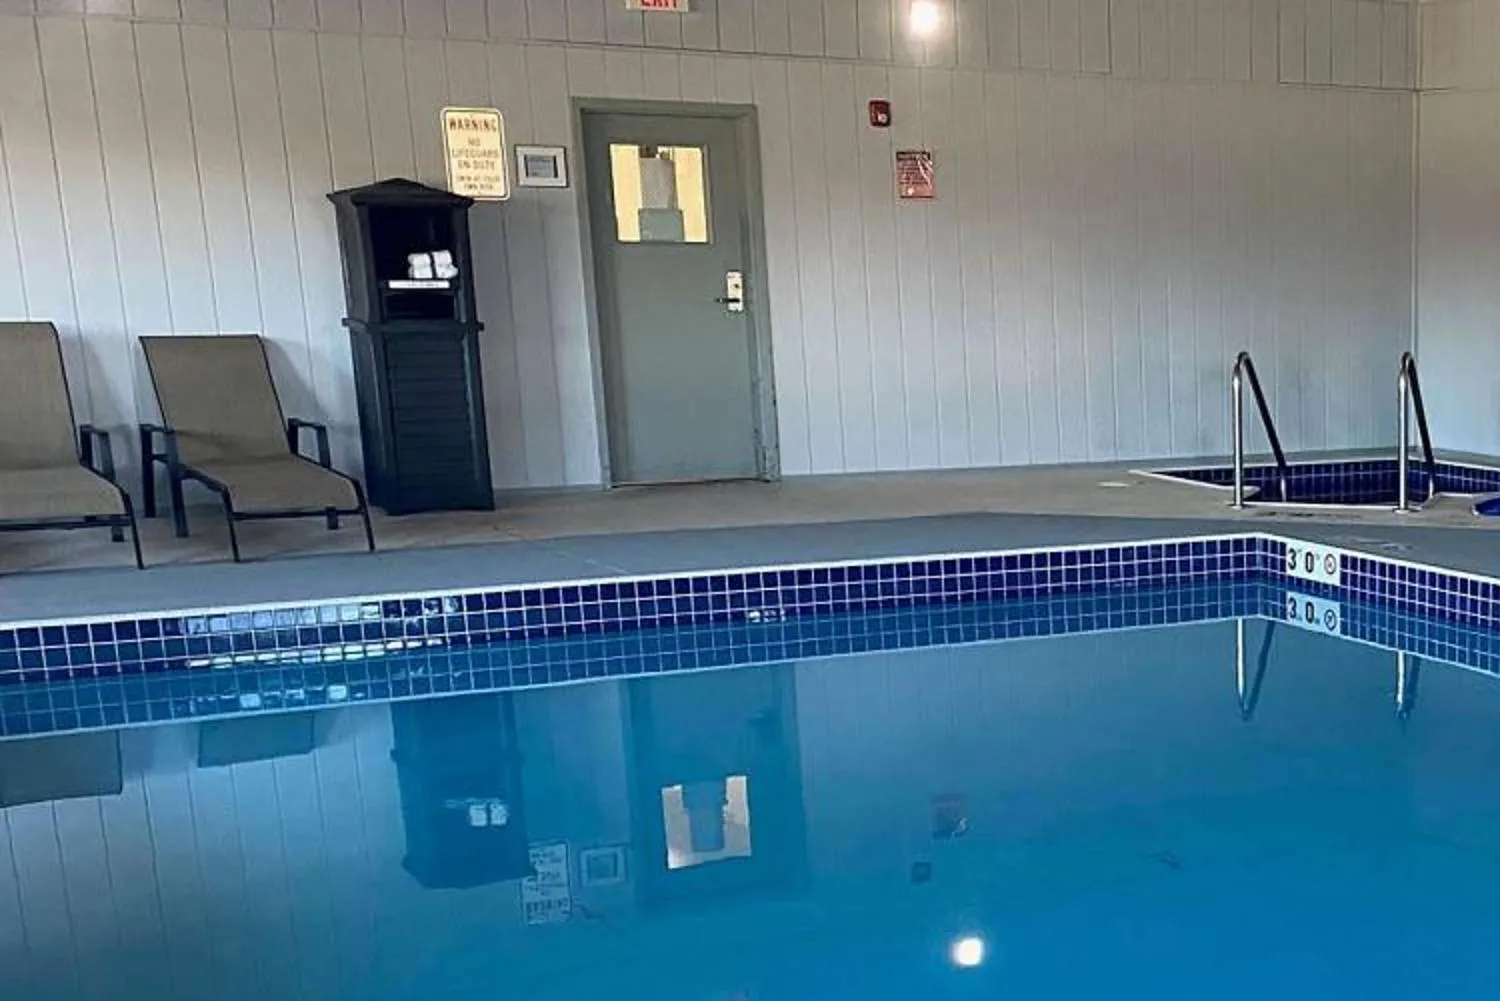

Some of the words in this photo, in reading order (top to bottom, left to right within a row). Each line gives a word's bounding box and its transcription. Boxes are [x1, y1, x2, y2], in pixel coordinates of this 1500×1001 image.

[449, 118, 498, 132] WARNING
[1288, 547, 1297, 570] 3
[1305, 551, 1315, 573] 0
